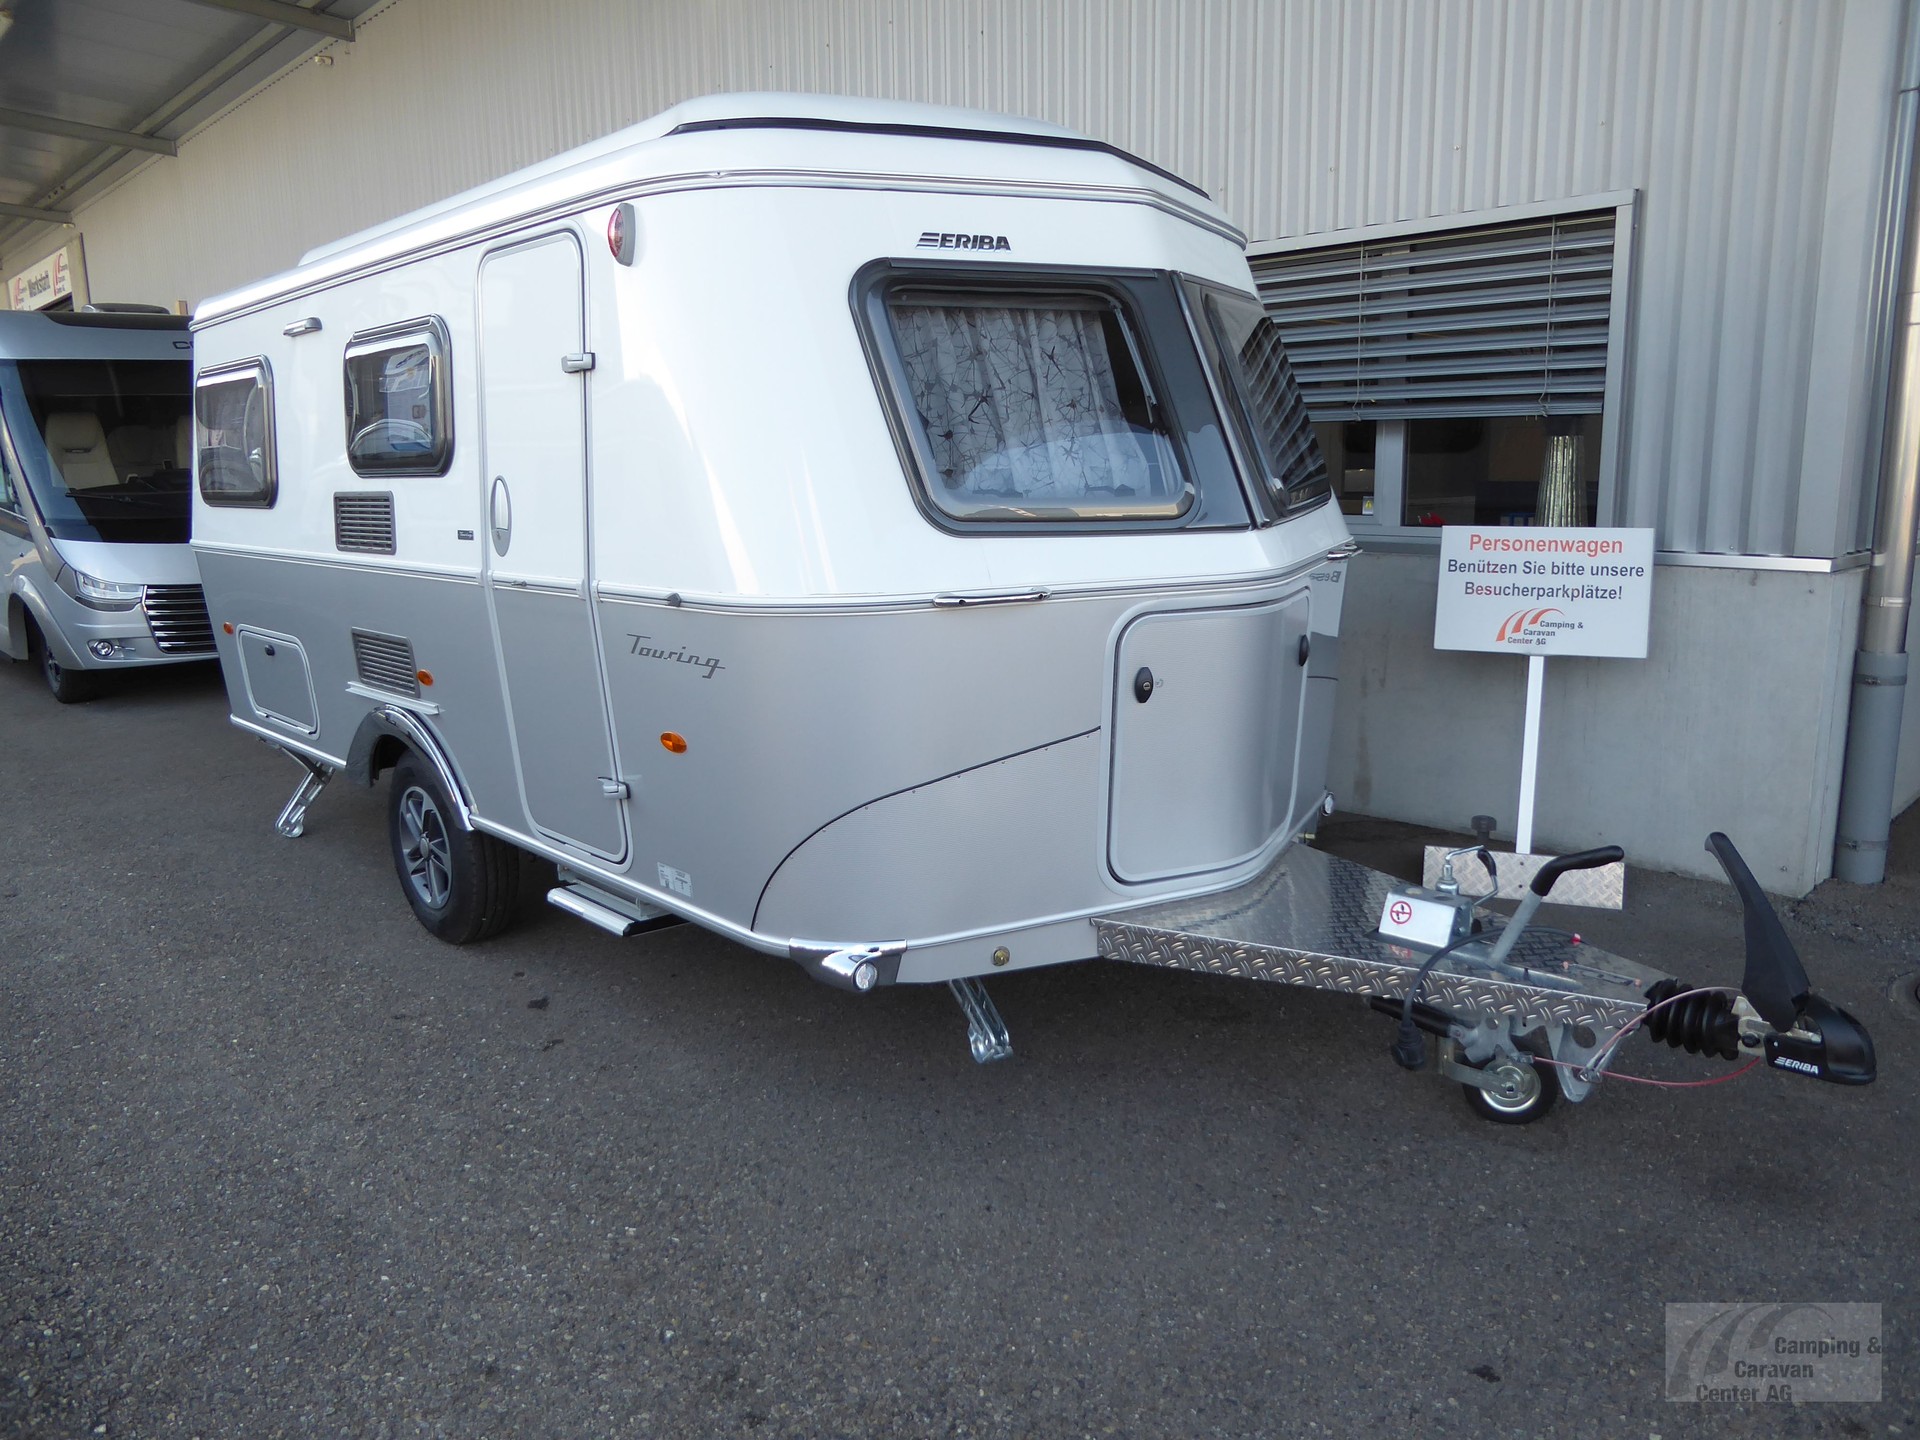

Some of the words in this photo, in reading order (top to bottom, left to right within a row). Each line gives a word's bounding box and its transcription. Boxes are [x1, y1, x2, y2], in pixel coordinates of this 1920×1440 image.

[937, 232, 1011, 251] ERIBA
[1469, 533, 1623, 558] Personenwagen
[1447, 558, 1518, 575] Benützen
[1522, 560, 1546, 575] Sie
[1551, 561, 1585, 576] bitte
[1590, 564, 1645, 577] unsere
[1464, 581, 1623, 602] Besucherparkplätze!
[1523, 628, 1556, 637] Caravan
[1539, 620, 1575, 630] Camping
[1507, 636, 1533, 645] Center
[1535, 638, 1547, 646] AG
[626, 633, 726, 680] Touring
[1784, 1058, 1820, 1075] ERIBA
